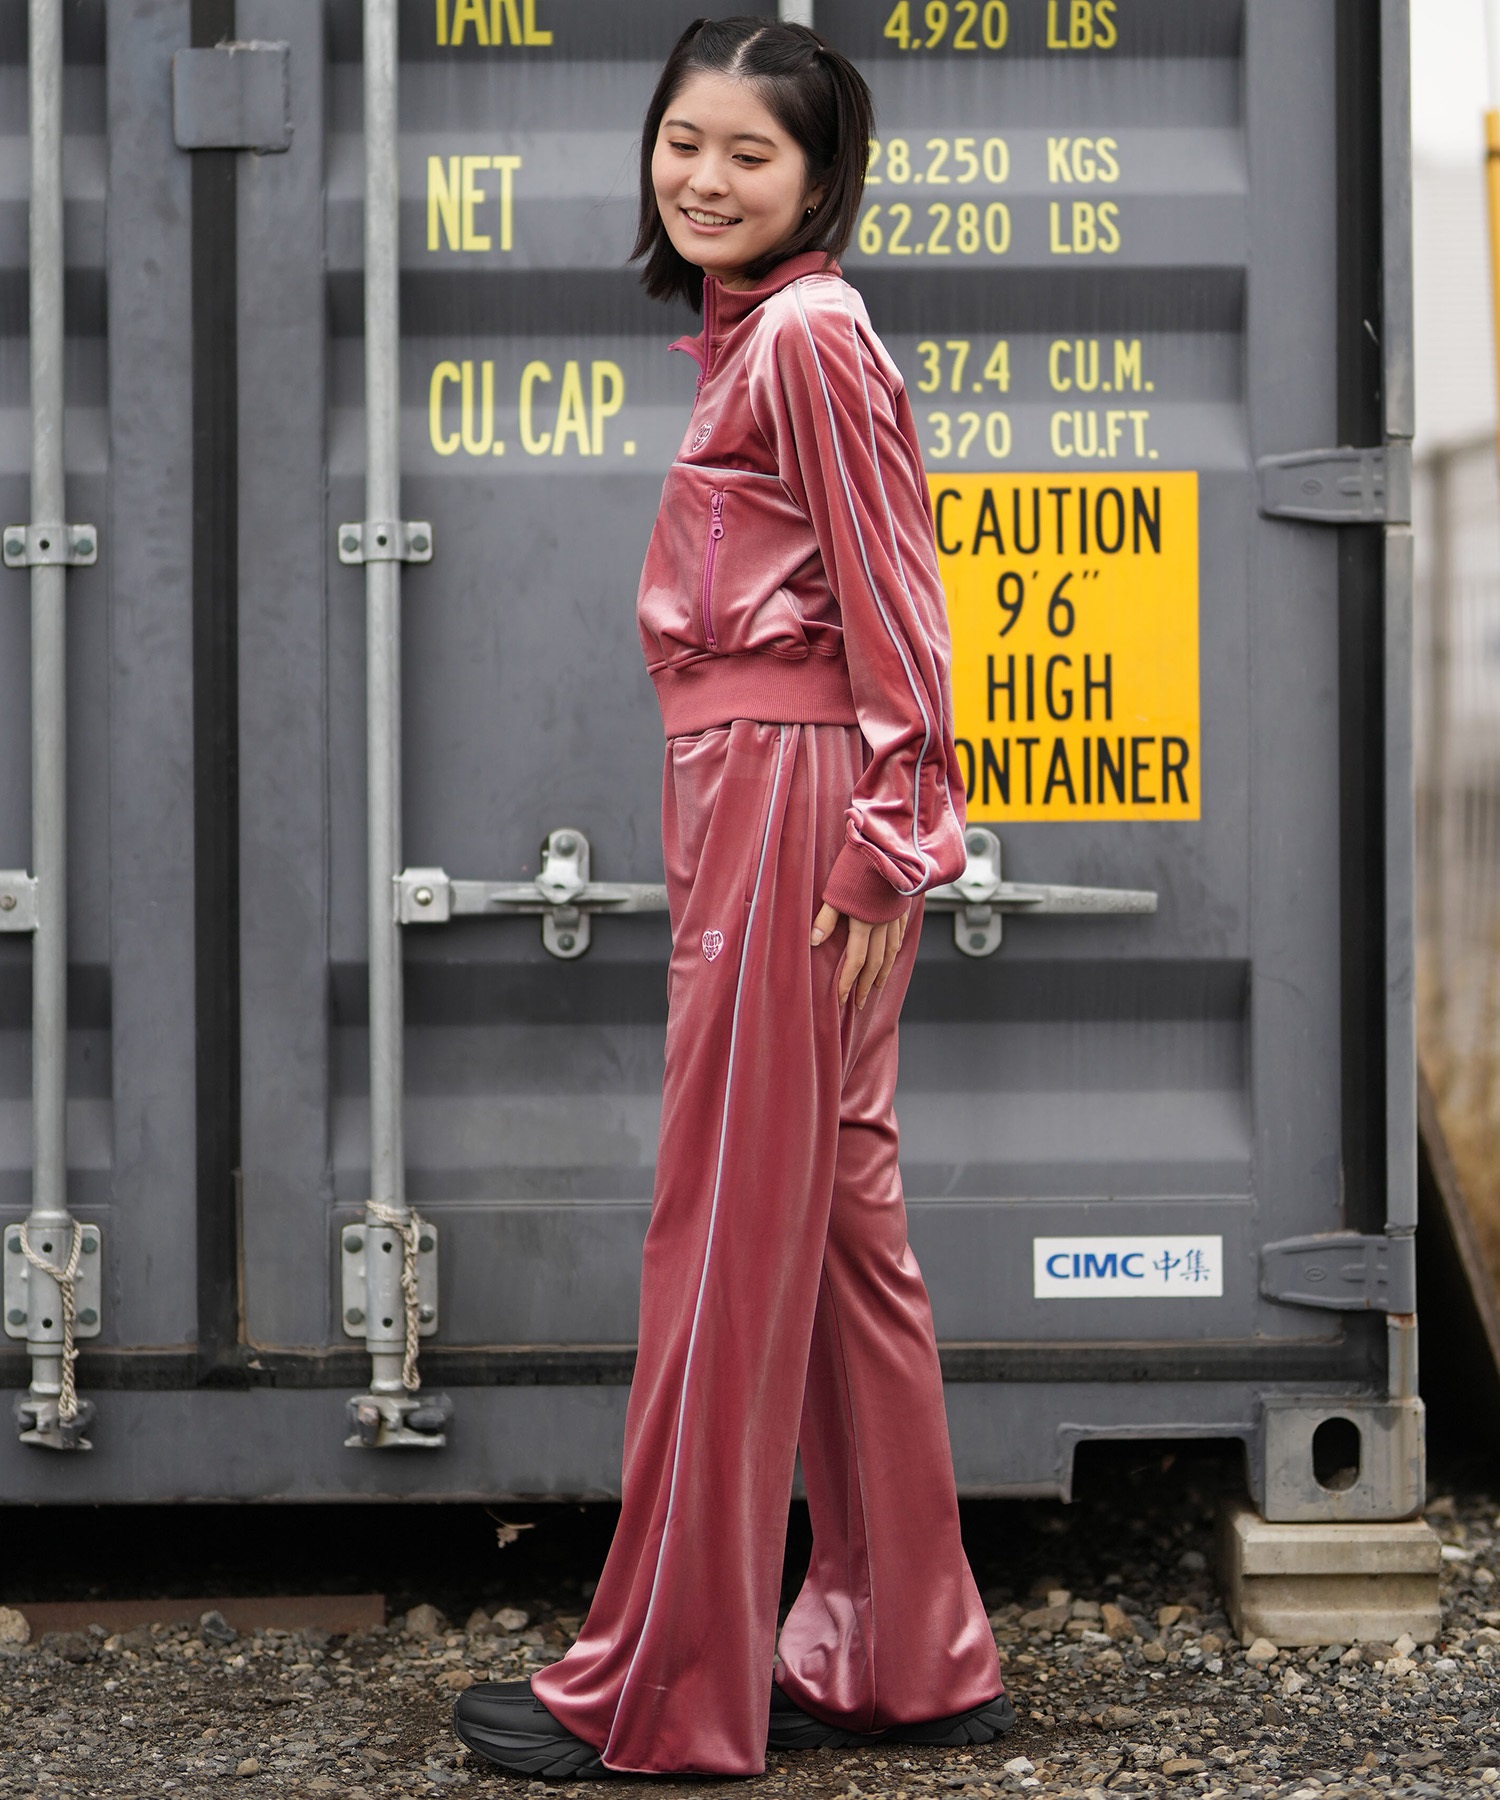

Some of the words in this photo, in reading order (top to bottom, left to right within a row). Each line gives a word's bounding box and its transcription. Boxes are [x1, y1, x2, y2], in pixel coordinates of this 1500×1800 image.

[883, 0, 1008, 50] 4,920
[1047, 0, 1118, 49] LBS
[1048, 138, 1120, 183] KGS
[427, 156, 520, 251] NET
[858, 202, 1011, 255] 62,280
[1050, 201, 1120, 254] LBS
[917, 340, 1010, 393] 37.4
[1049, 339, 1154, 391] CU.M.
[429, 360, 504, 456] CU.
[519, 360, 636, 456] CAP.
[1050, 411, 1158, 459] CU.FT.
[935, 487, 1161, 556] CAUTION
[987, 654, 1112, 722] HIGH
[954, 736, 1190, 805] ONTAINER
[1045, 1253, 1145, 1279] CIMC
[1153, 1249, 1210, 1282] 中集
